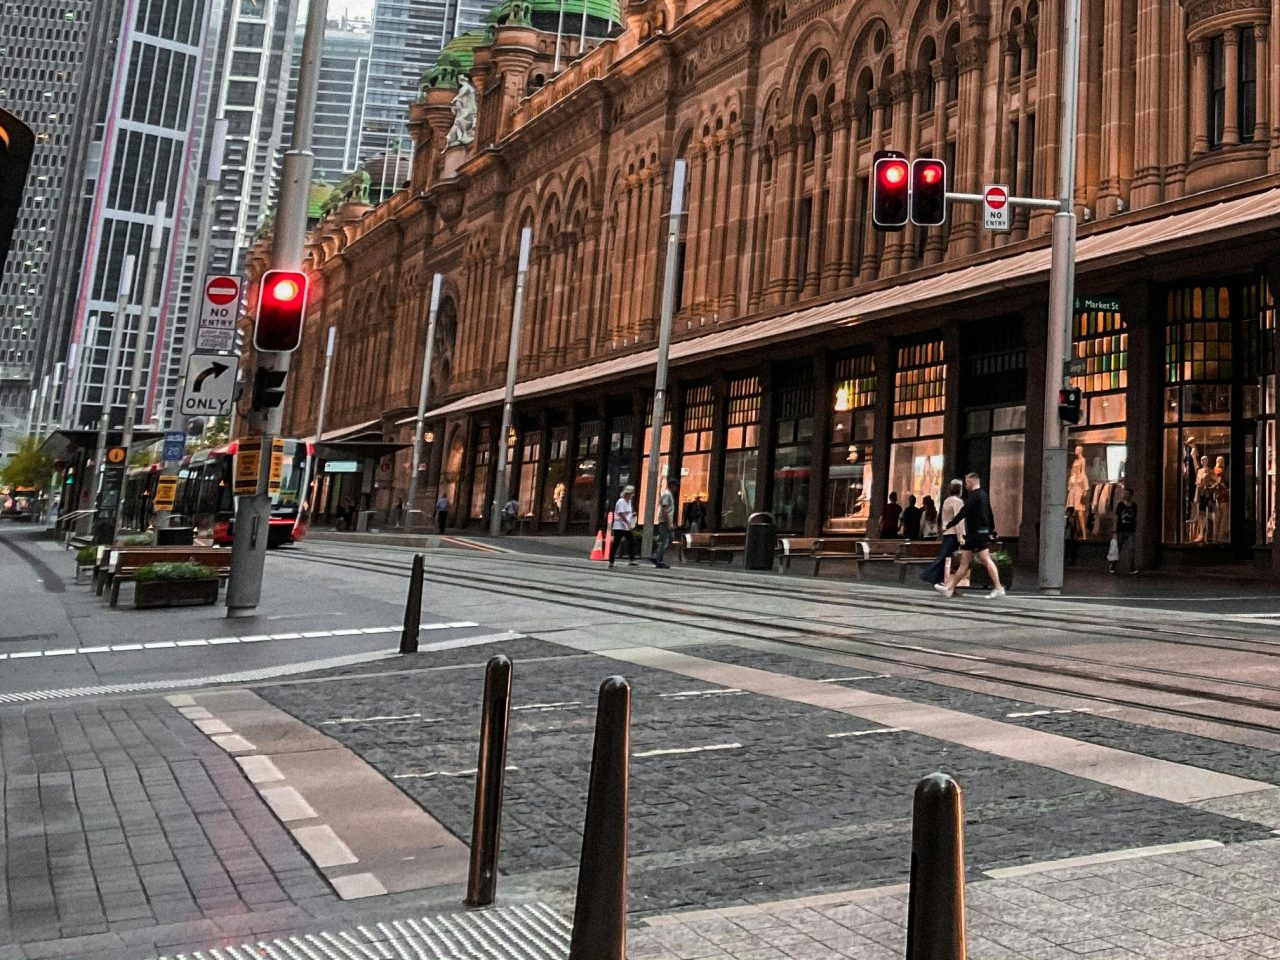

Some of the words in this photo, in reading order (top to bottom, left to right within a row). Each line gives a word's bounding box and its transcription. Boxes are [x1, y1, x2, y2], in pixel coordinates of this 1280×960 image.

[990, 211, 1002, 219] NO
[1085, 300, 1110, 310] Market
[1111, 302, 1119, 310] St
[210, 308, 229, 318] NO
[202, 319, 233, 327] ENTRY
[186, 398, 227, 410] ONLY
